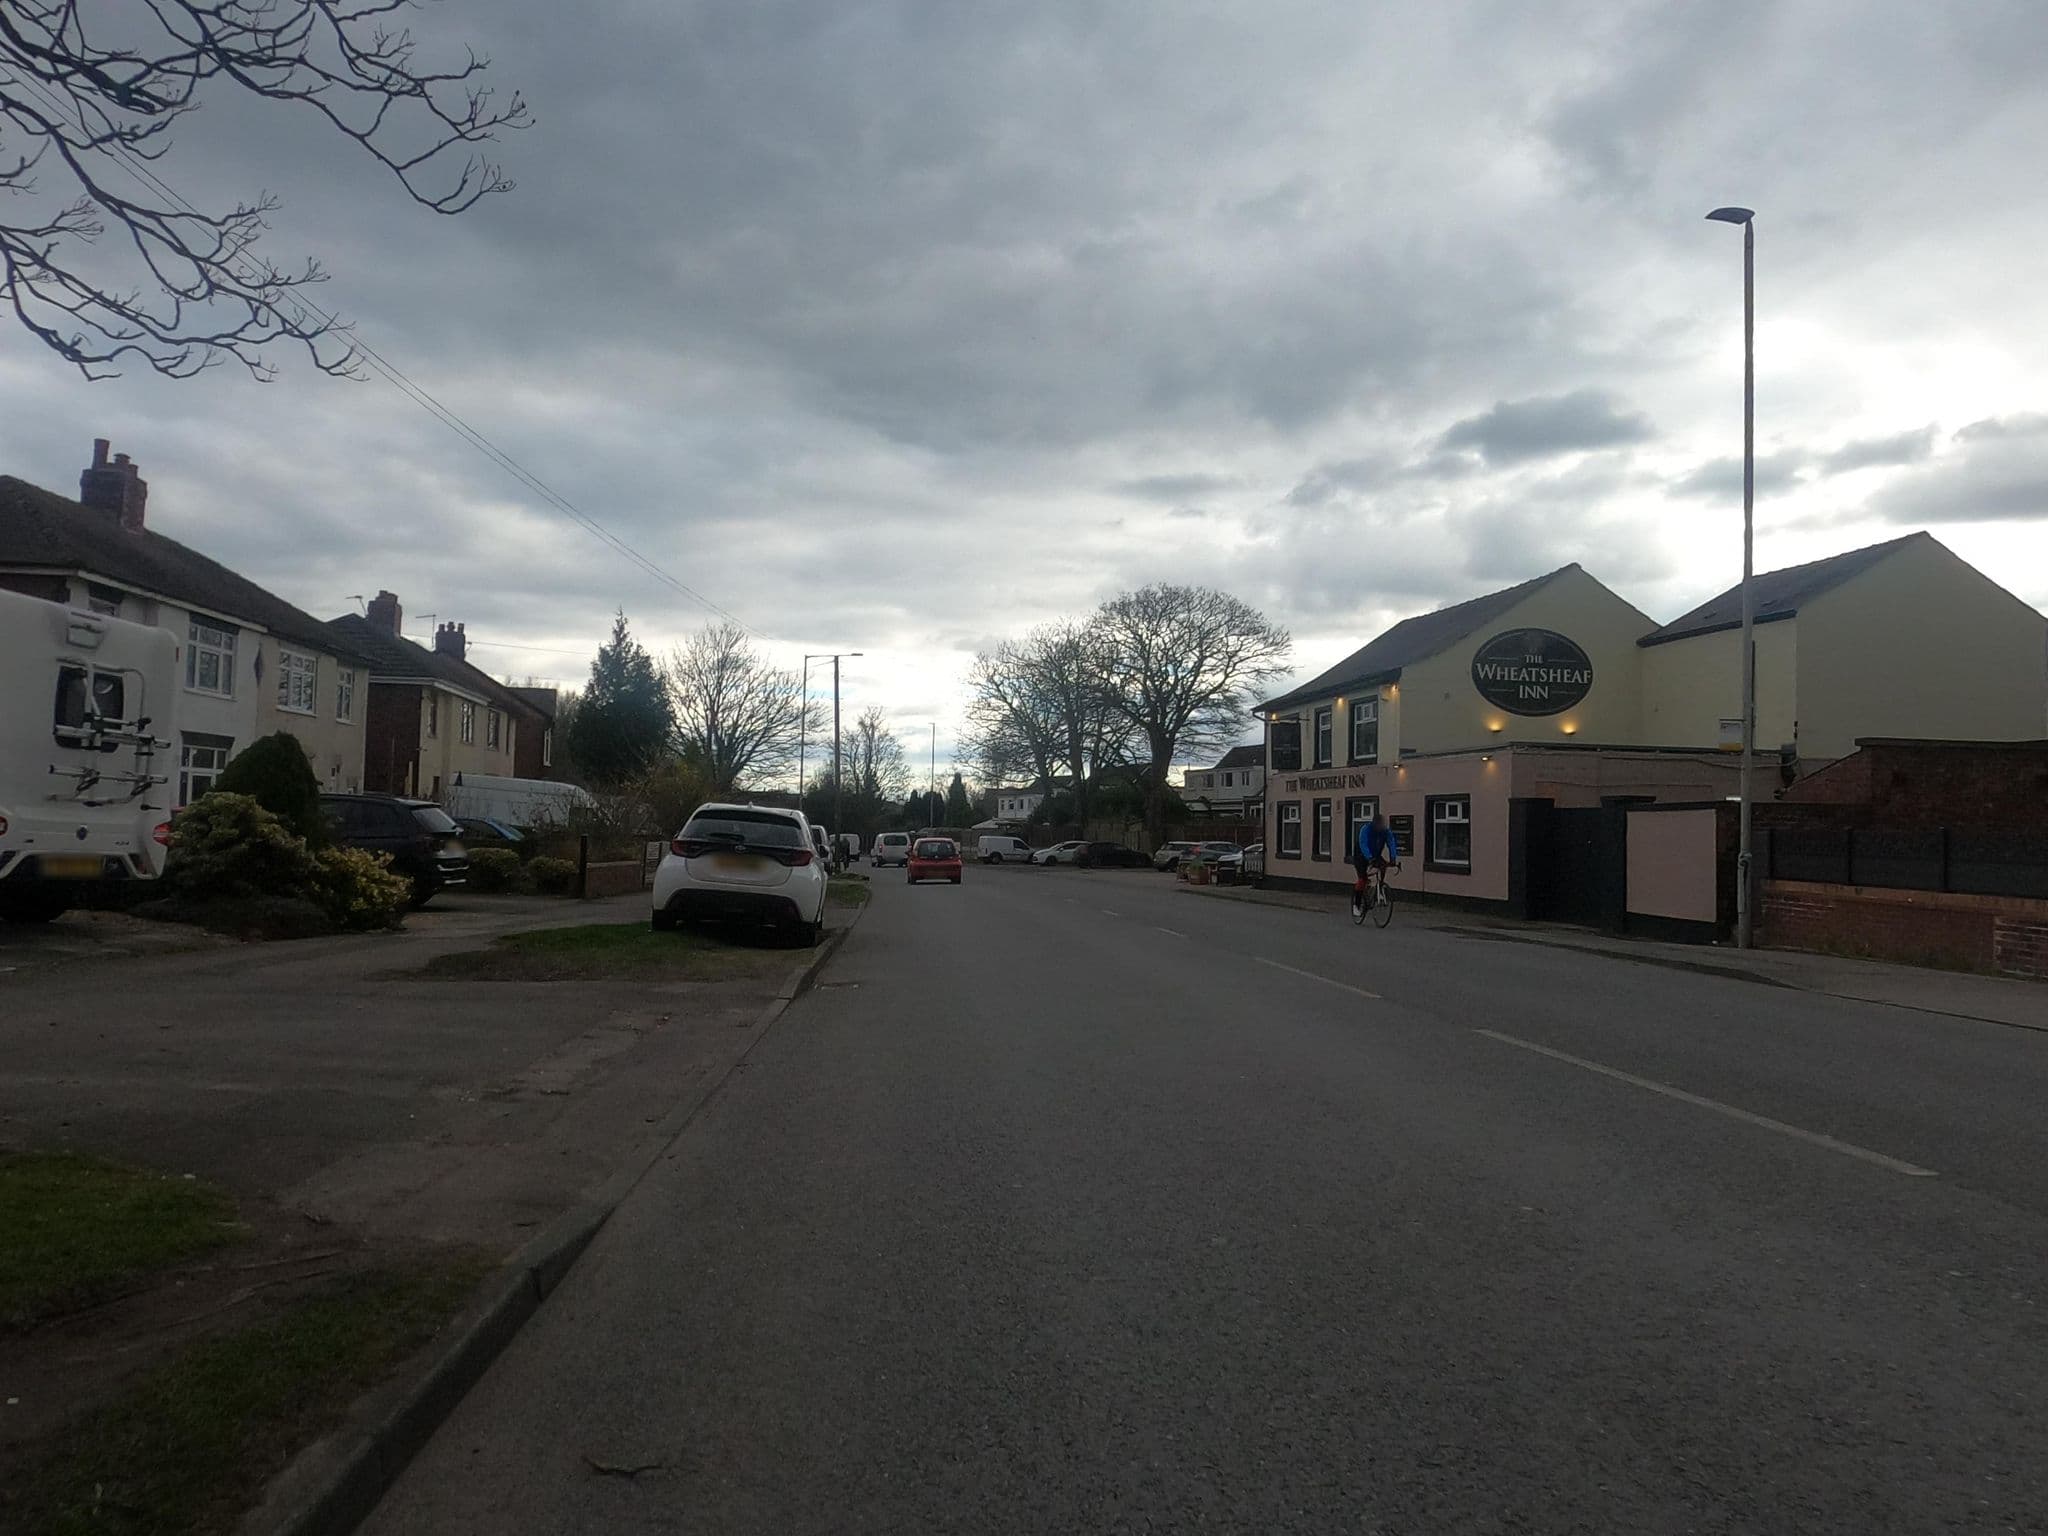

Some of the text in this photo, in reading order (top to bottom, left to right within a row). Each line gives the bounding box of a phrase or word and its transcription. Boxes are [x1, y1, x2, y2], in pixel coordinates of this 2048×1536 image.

[1525, 654, 1544, 664] THE
[1475, 663, 1591, 684] WHEATSHEAF
[1519, 685, 1548, 699] INN
[1298, 775, 1345, 791] WHEATSHEAF
[1348, 774, 1366, 788] INN
